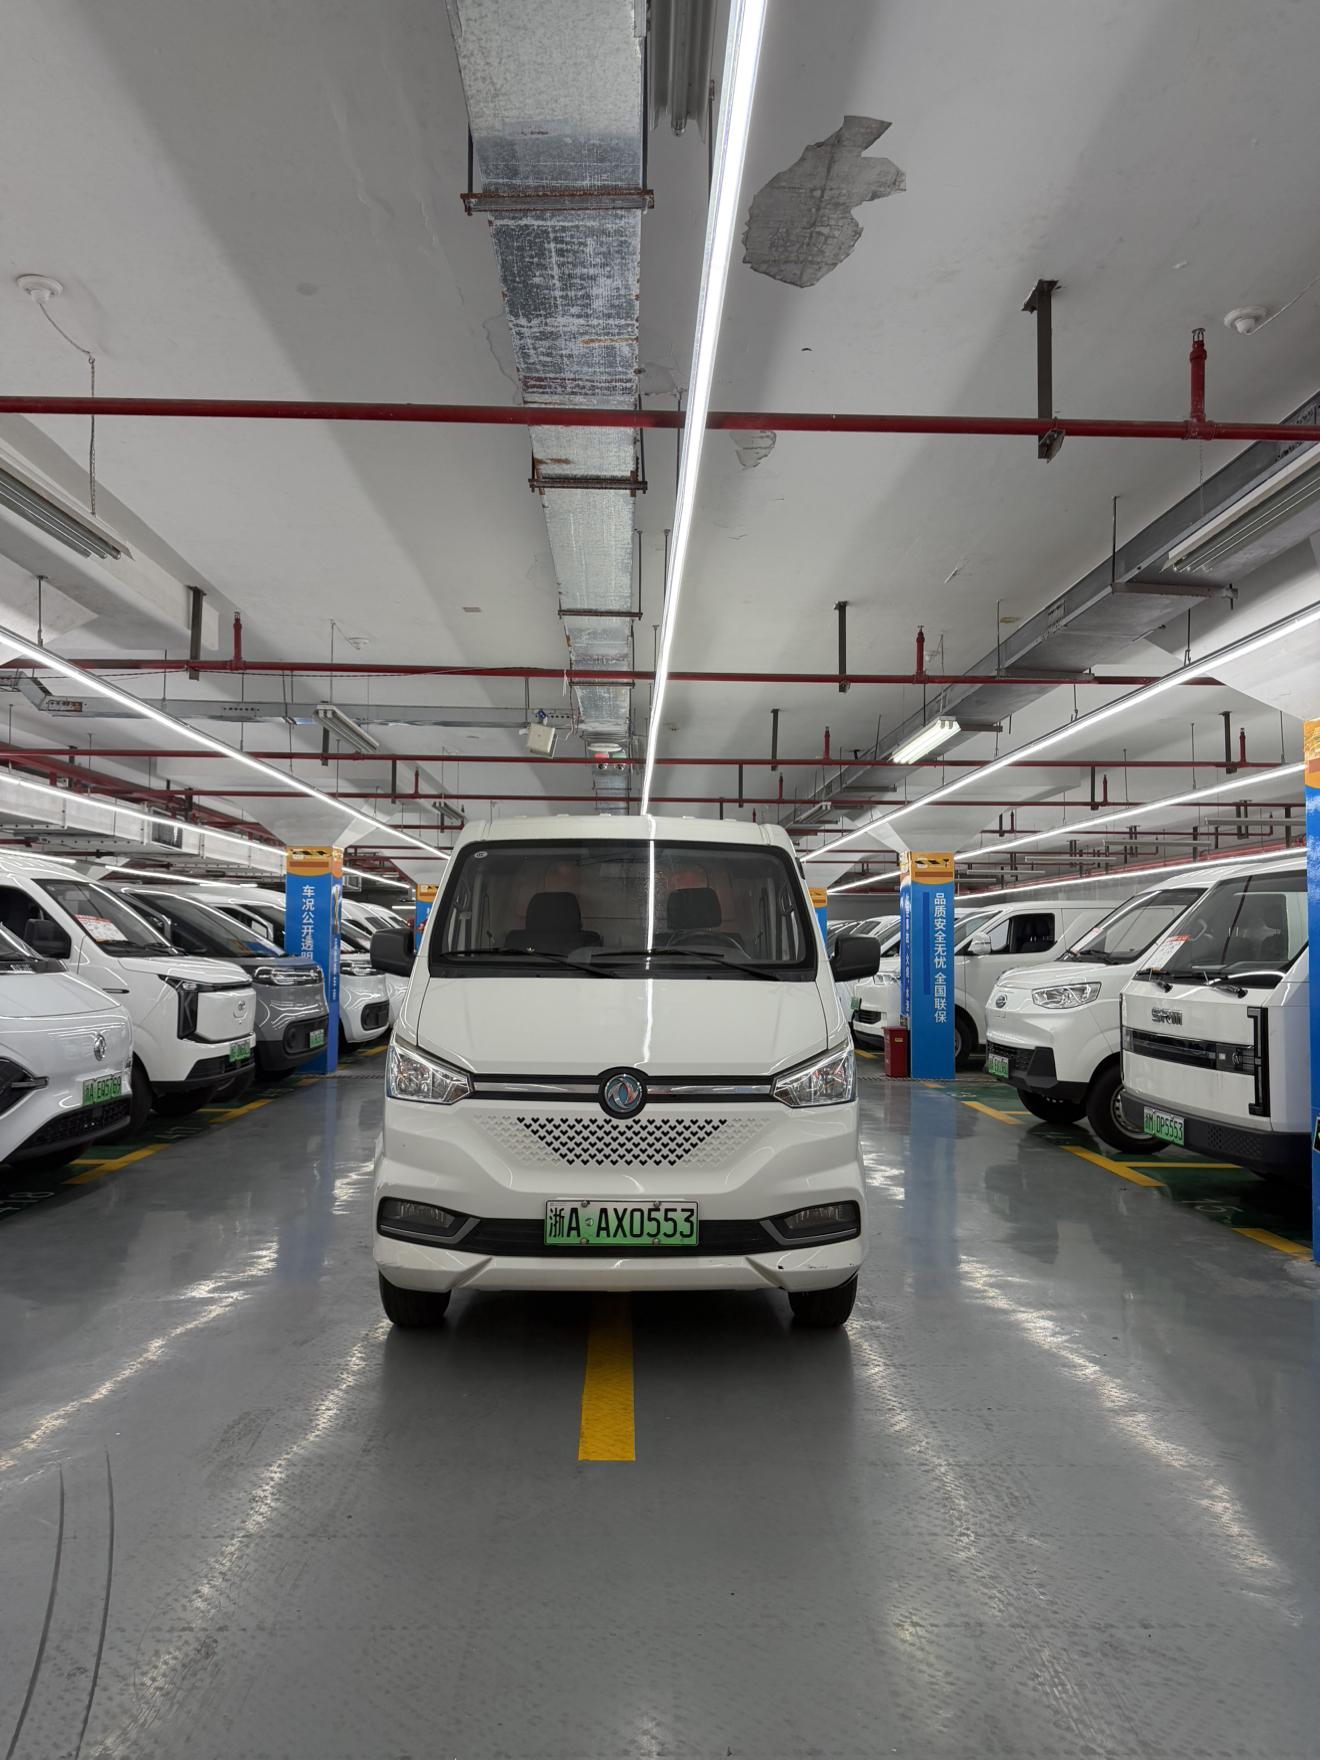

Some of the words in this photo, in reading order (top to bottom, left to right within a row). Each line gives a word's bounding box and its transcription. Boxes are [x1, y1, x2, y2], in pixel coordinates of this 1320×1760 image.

[301, 885, 315, 960] 车况公开透明
[934, 892, 947, 969] 品质安全无忧
[934, 972, 947, 1023] 全国联保
